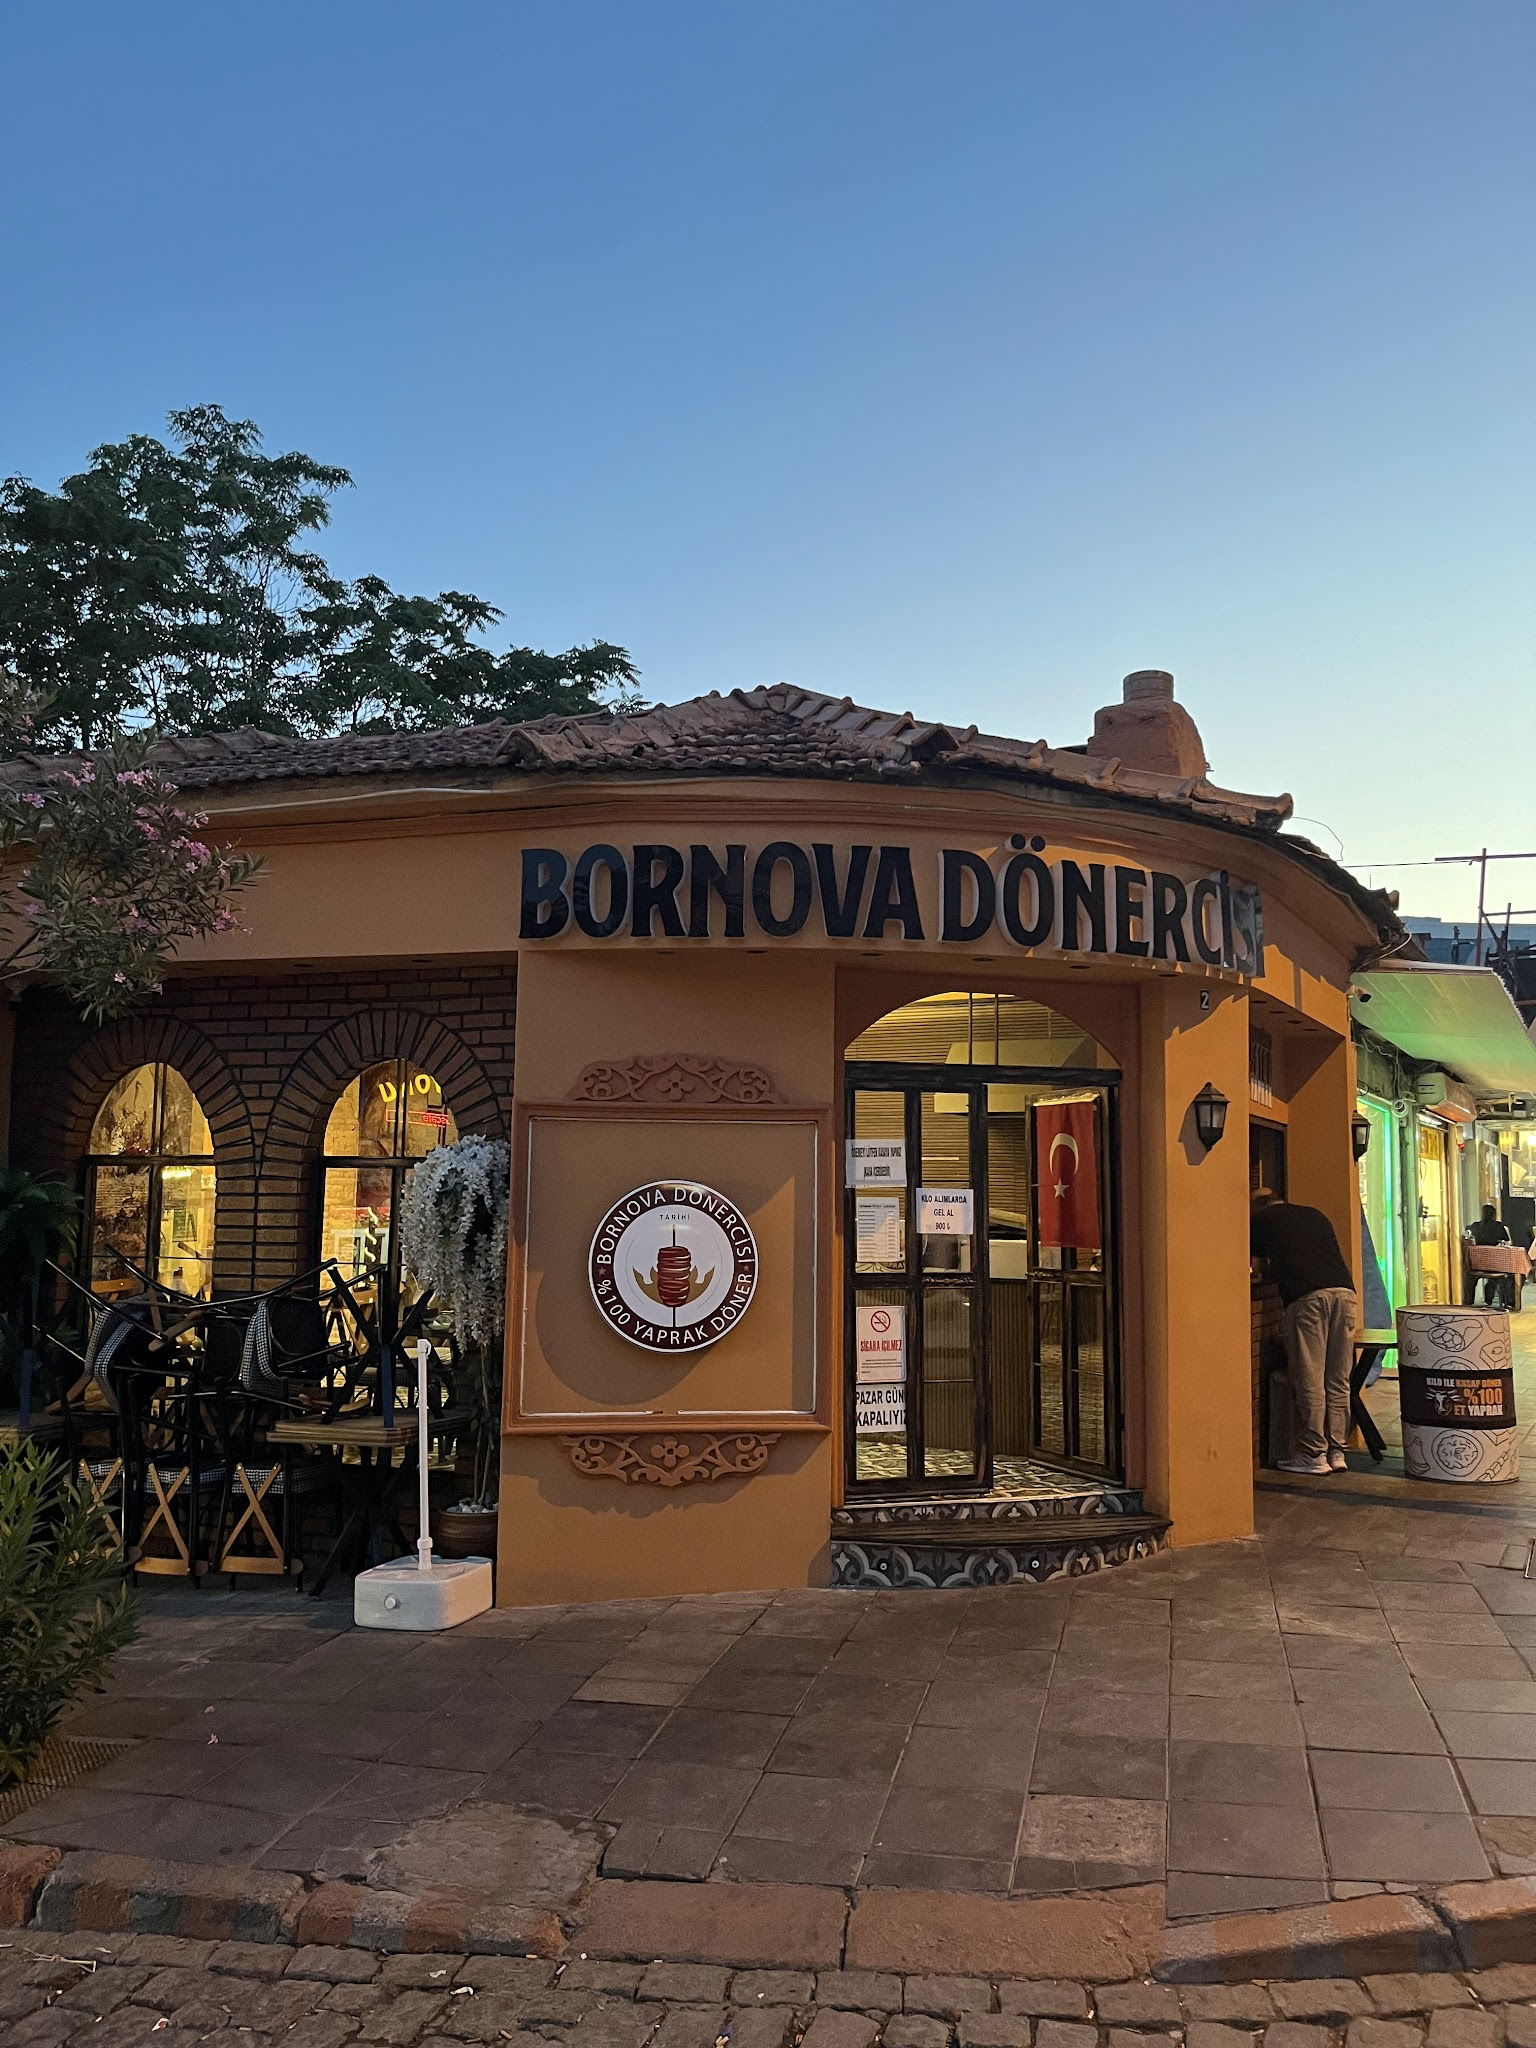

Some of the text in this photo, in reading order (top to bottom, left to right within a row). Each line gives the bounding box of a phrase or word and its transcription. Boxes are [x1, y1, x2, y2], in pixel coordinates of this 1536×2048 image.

[518, 841, 926, 940] BORNOVA
[1201, 991, 1209, 1009] 2
[934, 1209, 945, 1217] GEL
[597, 1188, 666, 1265] BORNOVA
[935, 1222, 946, 1230] 900
[634, 1321, 708, 1345] YAPRAK
[711, 1273, 752, 1331] DÖNER
[860, 1338, 902, 1353] SİGARA İÇİLMEZ
[855, 1386, 907, 1405] PAZAR GÜN
[1463, 1388, 1503, 1405] %100
[1454, 1404, 1504, 1416] ET YAPRAK
